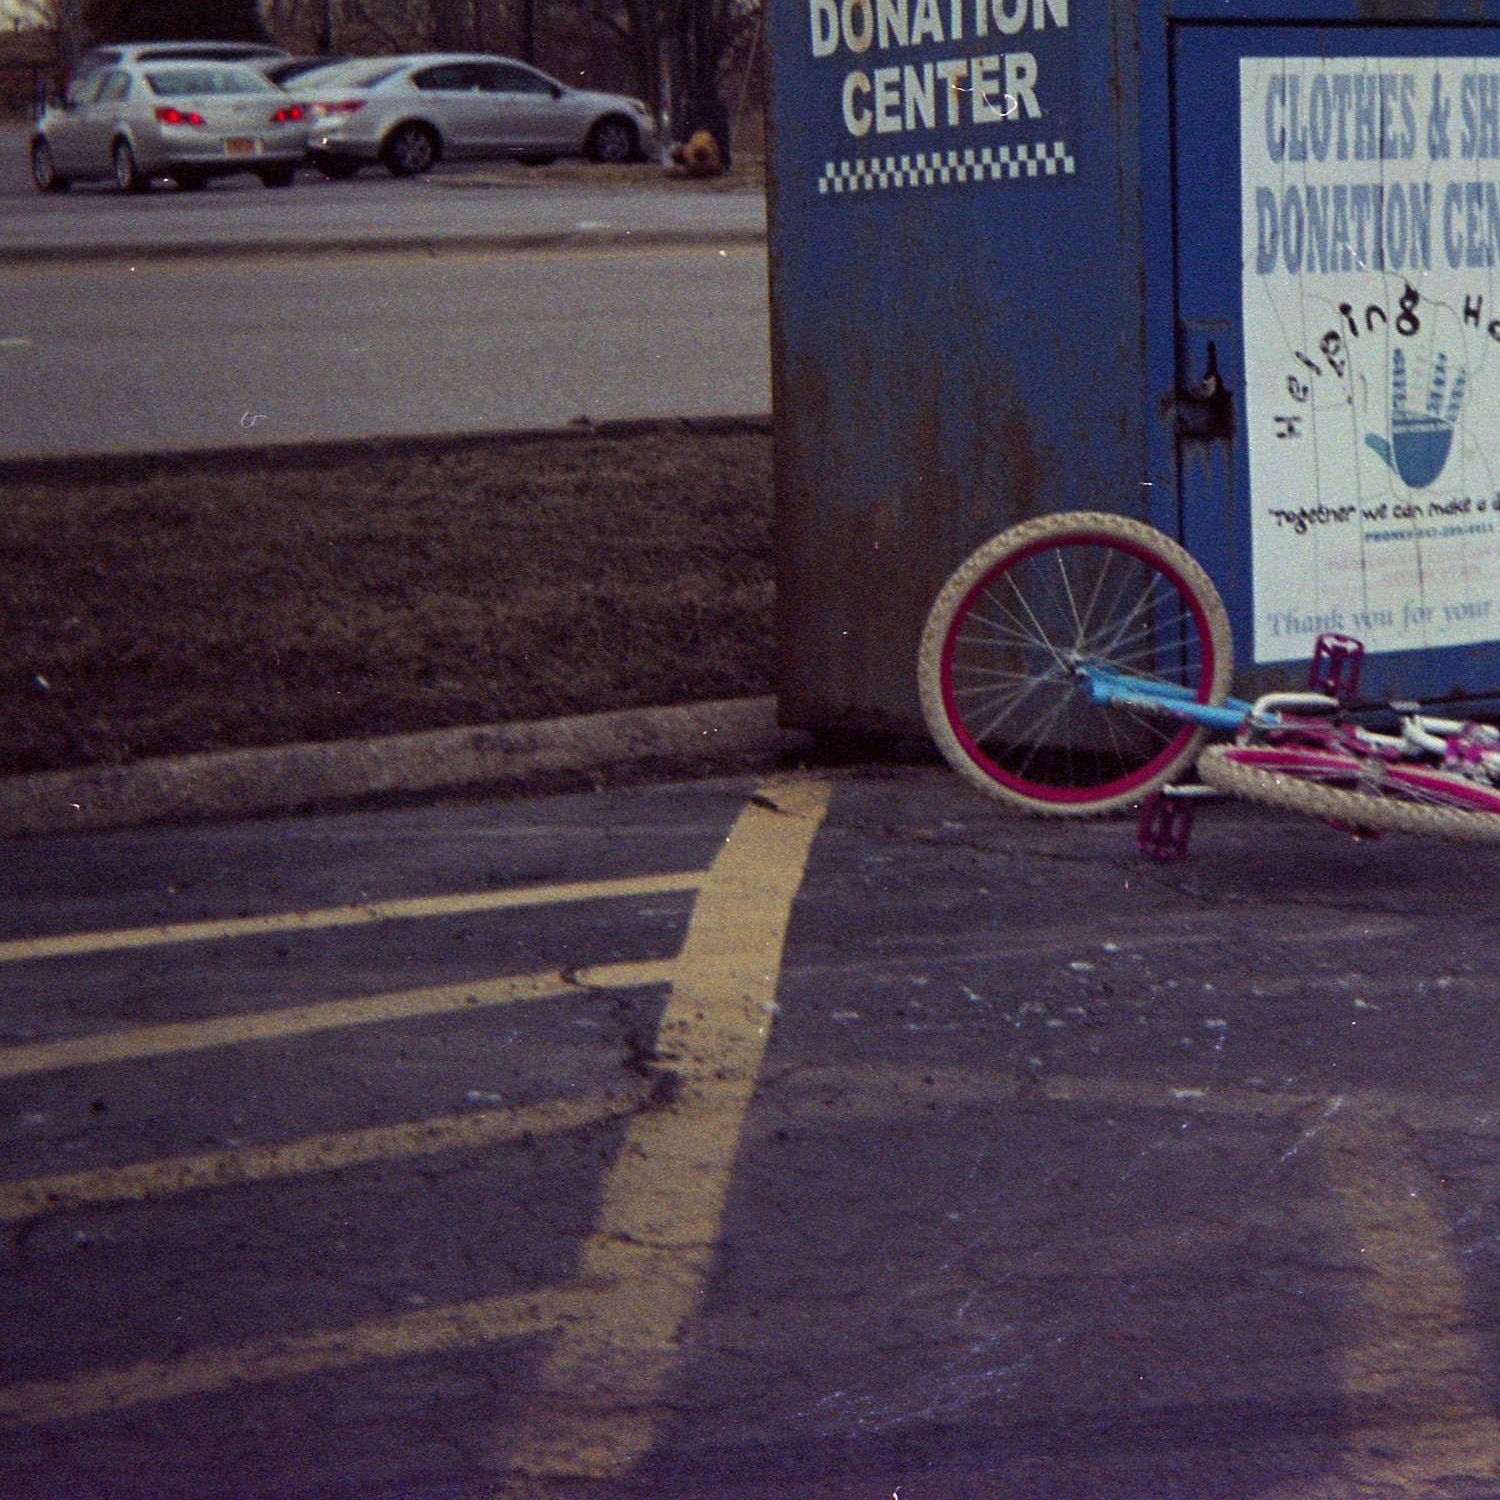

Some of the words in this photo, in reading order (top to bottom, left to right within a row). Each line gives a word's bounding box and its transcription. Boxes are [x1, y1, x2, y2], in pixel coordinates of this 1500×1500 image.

[843, 50, 1042, 137] CENTER
[1265, 74, 1416, 163] CLOTHES
[1427, 73, 1450, 161] &
[1256, 181, 1432, 275] DONATION
[1274, 283, 1421, 439] Helping
[1362, 502, 1388, 522] we
[1393, 502, 1423, 520] can
[1429, 497, 1471, 517] make
[1477, 498, 1487, 512] a
[1268, 604, 1343, 637] Thank
[1352, 608, 1393, 632] you
[1403, 601, 1436, 629] for
[1442, 599, 1493, 631] your
